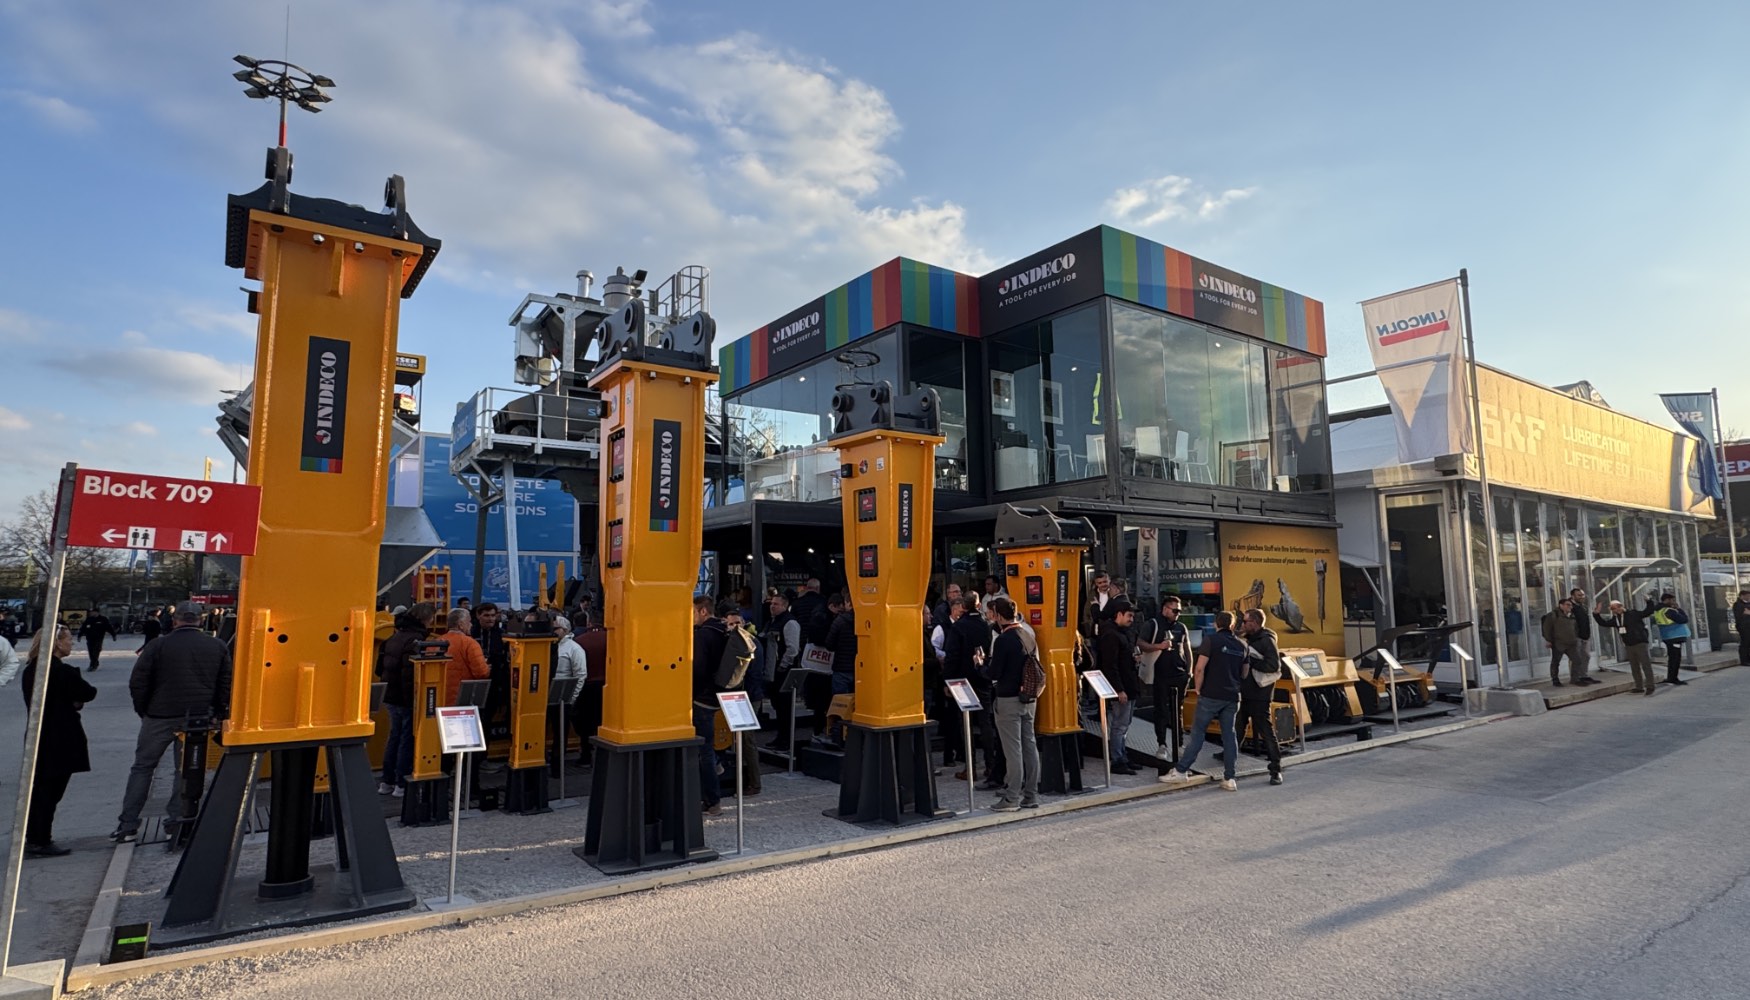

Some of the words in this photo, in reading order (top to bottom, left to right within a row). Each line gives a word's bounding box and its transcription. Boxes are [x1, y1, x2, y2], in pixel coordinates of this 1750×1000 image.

[1011, 253, 1076, 291] INDECO
[1004, 294, 1023, 305] TOOL
[1023, 287, 1038, 298] FOR
[1038, 278, 1061, 293] EVERY
[1062, 272, 1077, 283] JOB
[1204, 293, 1219, 304] TOOL
[1219, 297, 1230, 307] FOR
[1209, 275, 1256, 304] INDECO
[780, 311, 820, 341] INDECO
[317, 351, 337, 429] INDECO
[1481, 403, 1546, 456] SKF
[1563, 424, 1630, 456] LUBRICATION
[659, 431, 673, 495] INDECO
[1564, 449, 1615, 474] LIFETIME
[82, 475, 157, 500] Block
[165, 483, 213, 504] 709
[810, 649, 832, 662] PERI
